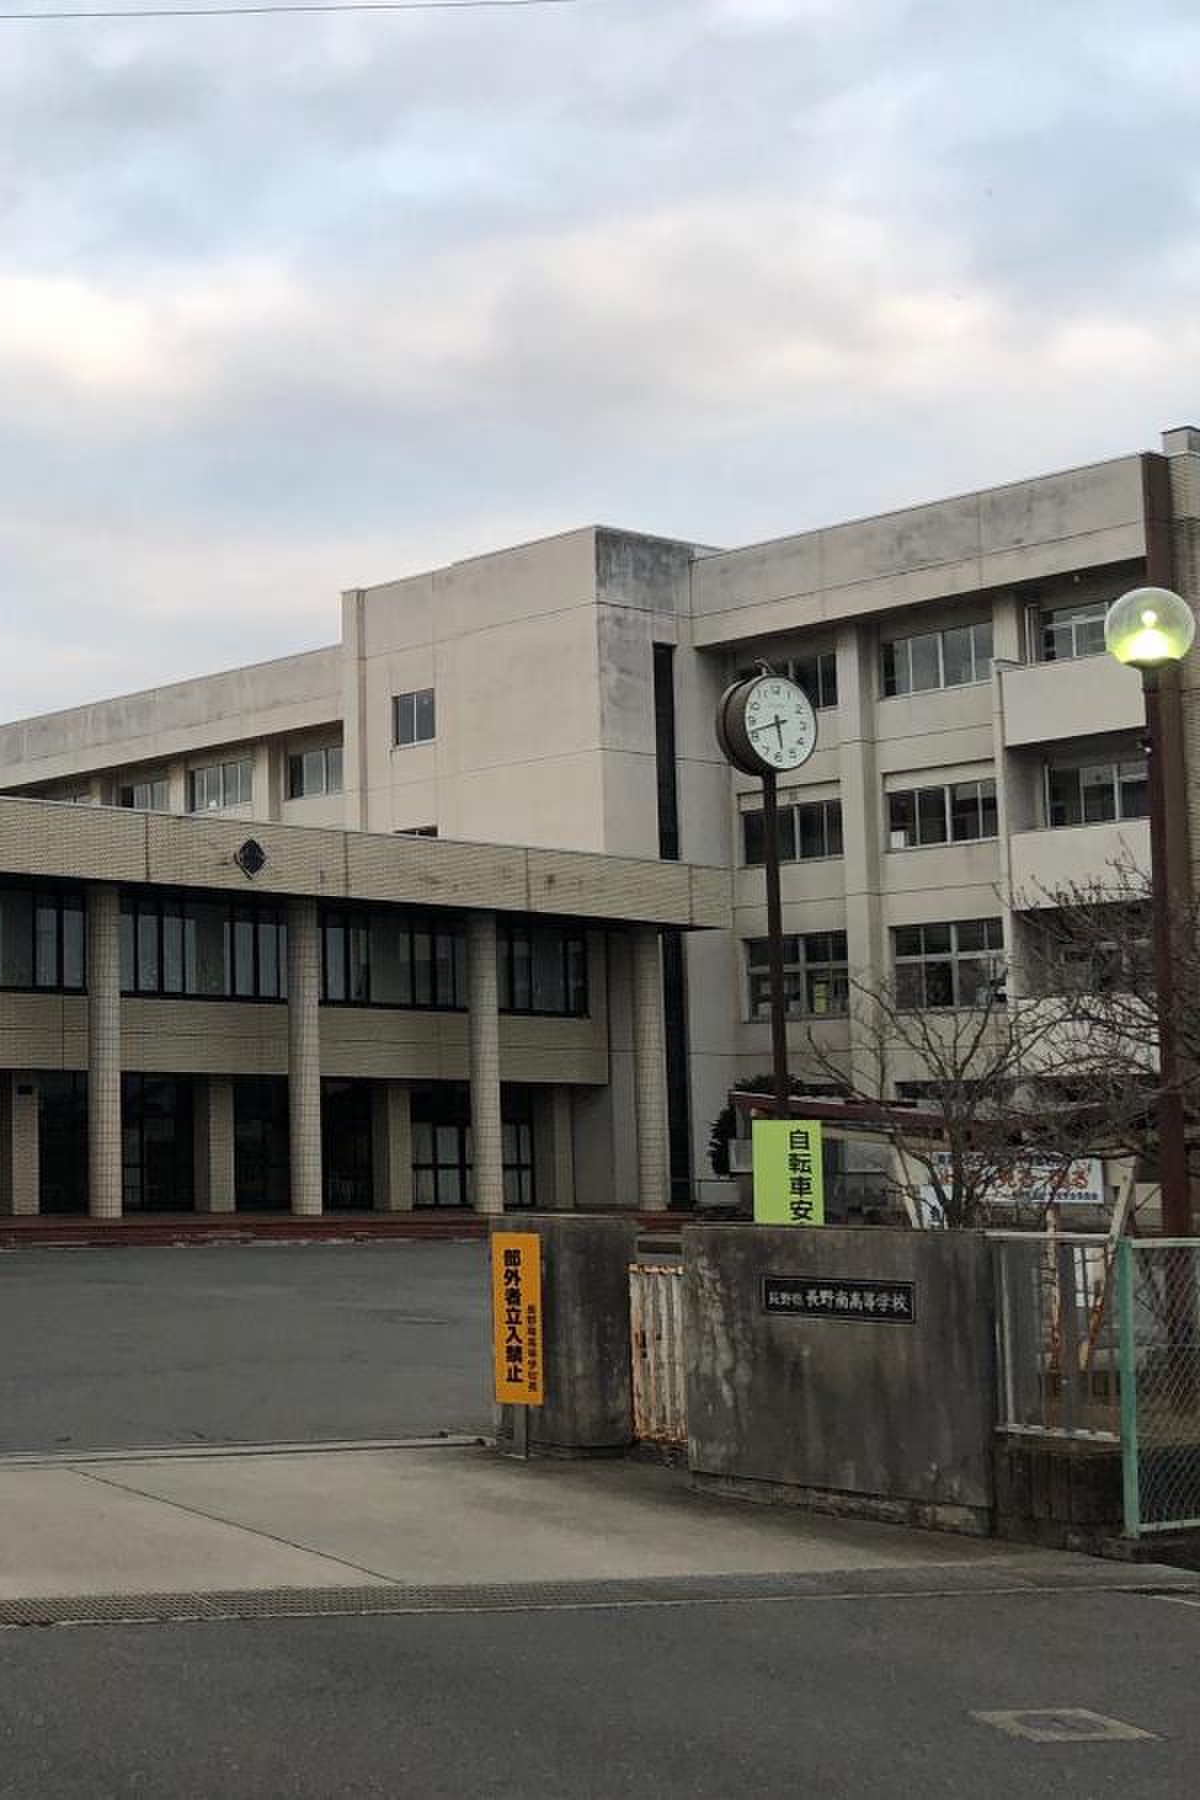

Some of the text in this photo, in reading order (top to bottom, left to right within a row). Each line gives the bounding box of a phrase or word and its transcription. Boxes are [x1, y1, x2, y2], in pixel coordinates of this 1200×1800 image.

[503, 1248, 523, 1383] 部外者立入禁止
